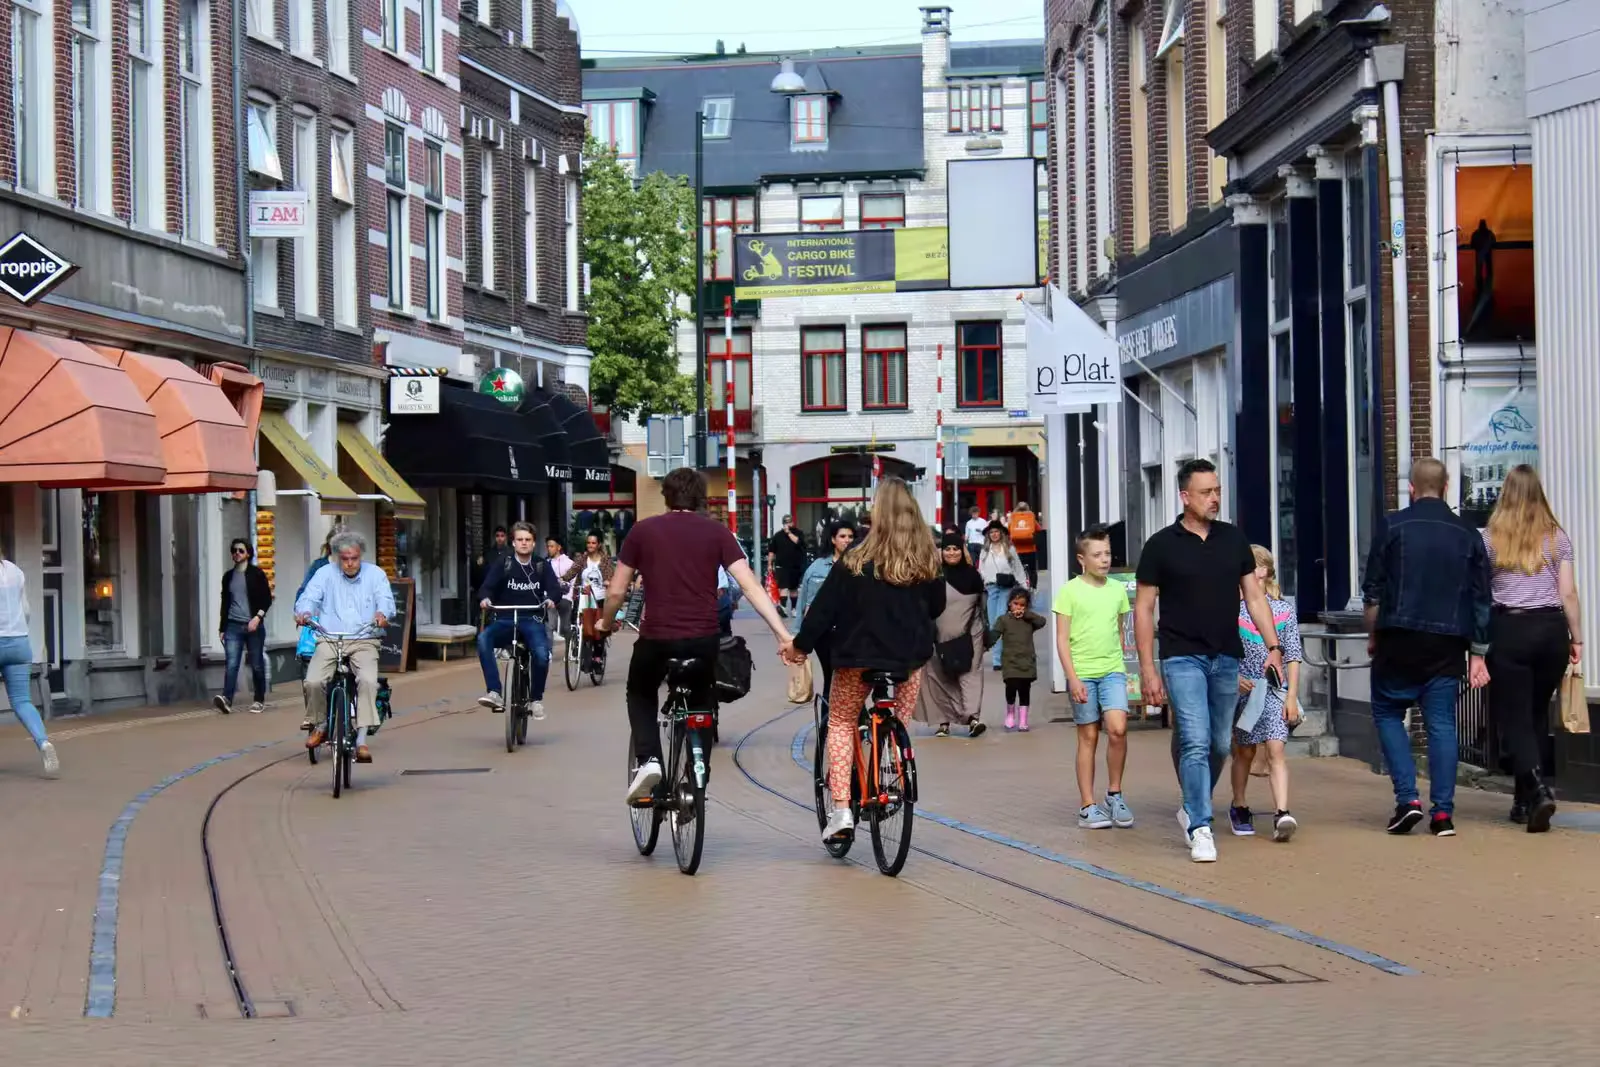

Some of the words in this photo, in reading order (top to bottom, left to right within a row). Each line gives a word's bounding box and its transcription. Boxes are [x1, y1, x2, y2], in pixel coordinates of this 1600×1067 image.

[270, 207, 299, 221] AM
[787, 237, 856, 248] INTERNATIONAL
[787, 250, 828, 261] CARGO
[830, 249, 856, 259] BIKE
[0, 258, 57, 277] roppie
[787, 264, 856, 279] FESTIVAL
